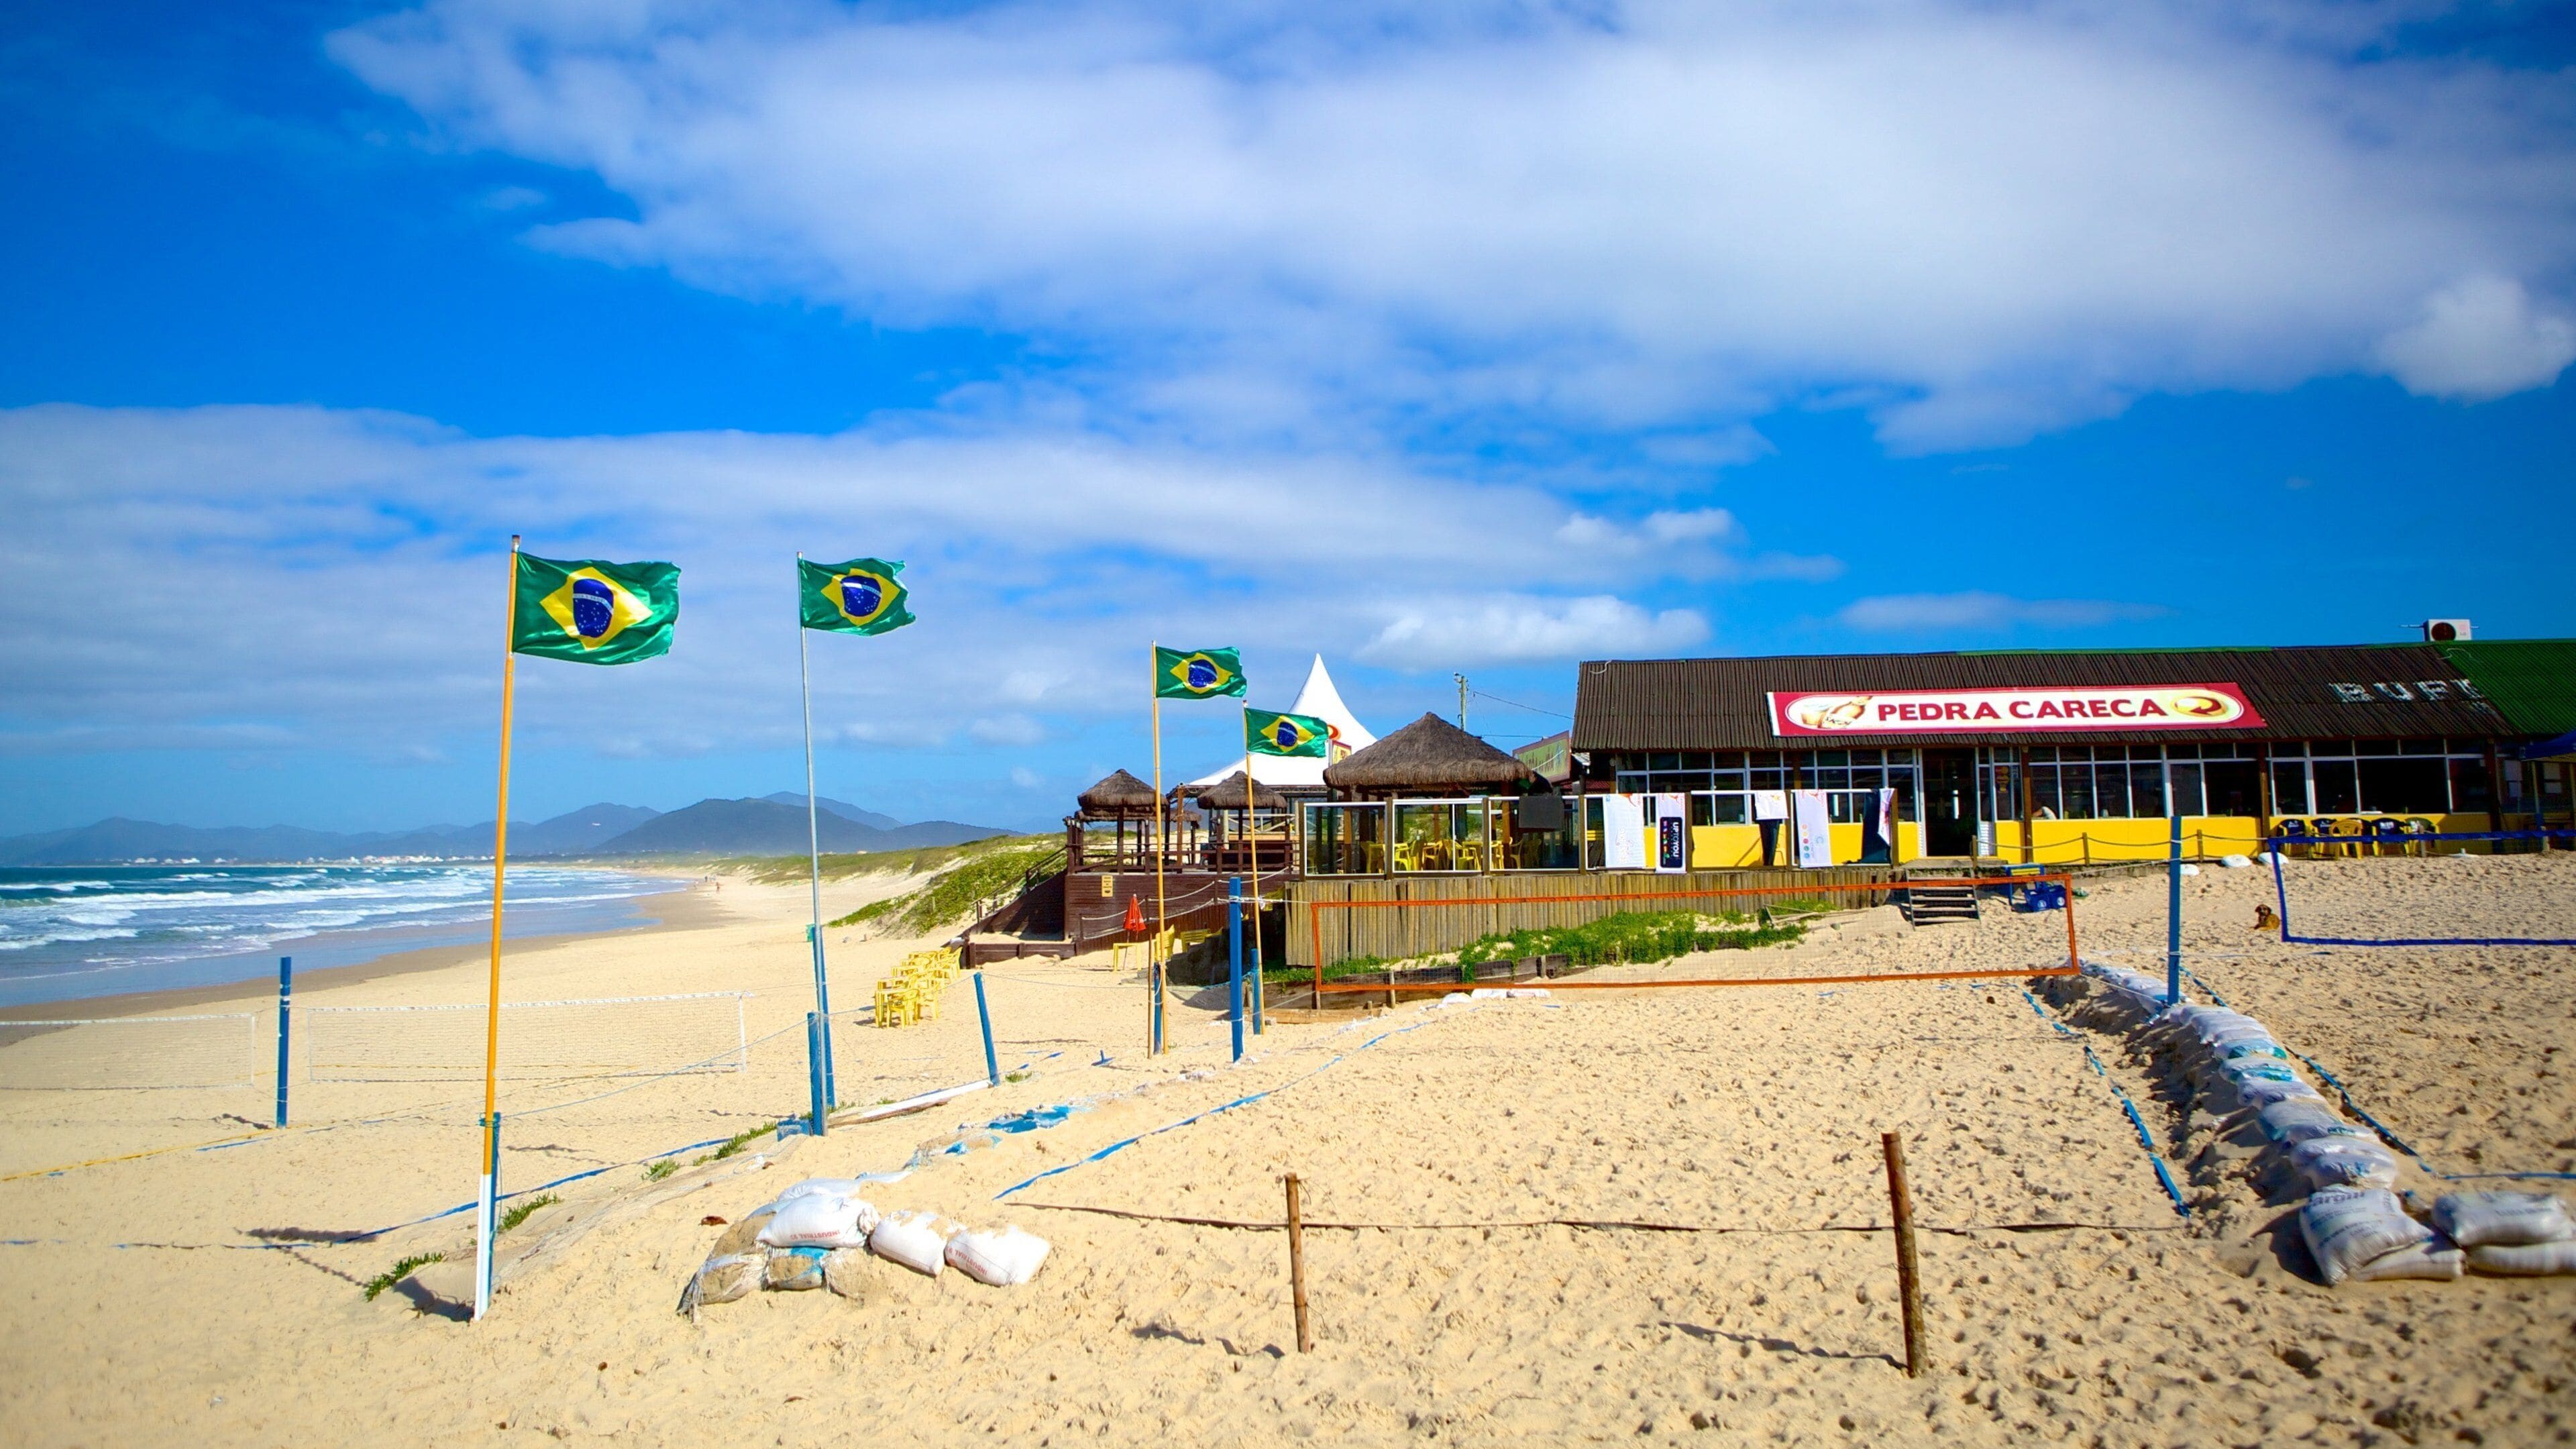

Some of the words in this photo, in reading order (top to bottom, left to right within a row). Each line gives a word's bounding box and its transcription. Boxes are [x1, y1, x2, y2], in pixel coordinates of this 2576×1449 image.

[1878, 702, 2002, 721] PEDRA
[2009, 698, 2168, 718] CARECA
[799, 1230, 841, 1239] INDUSTRIAL
